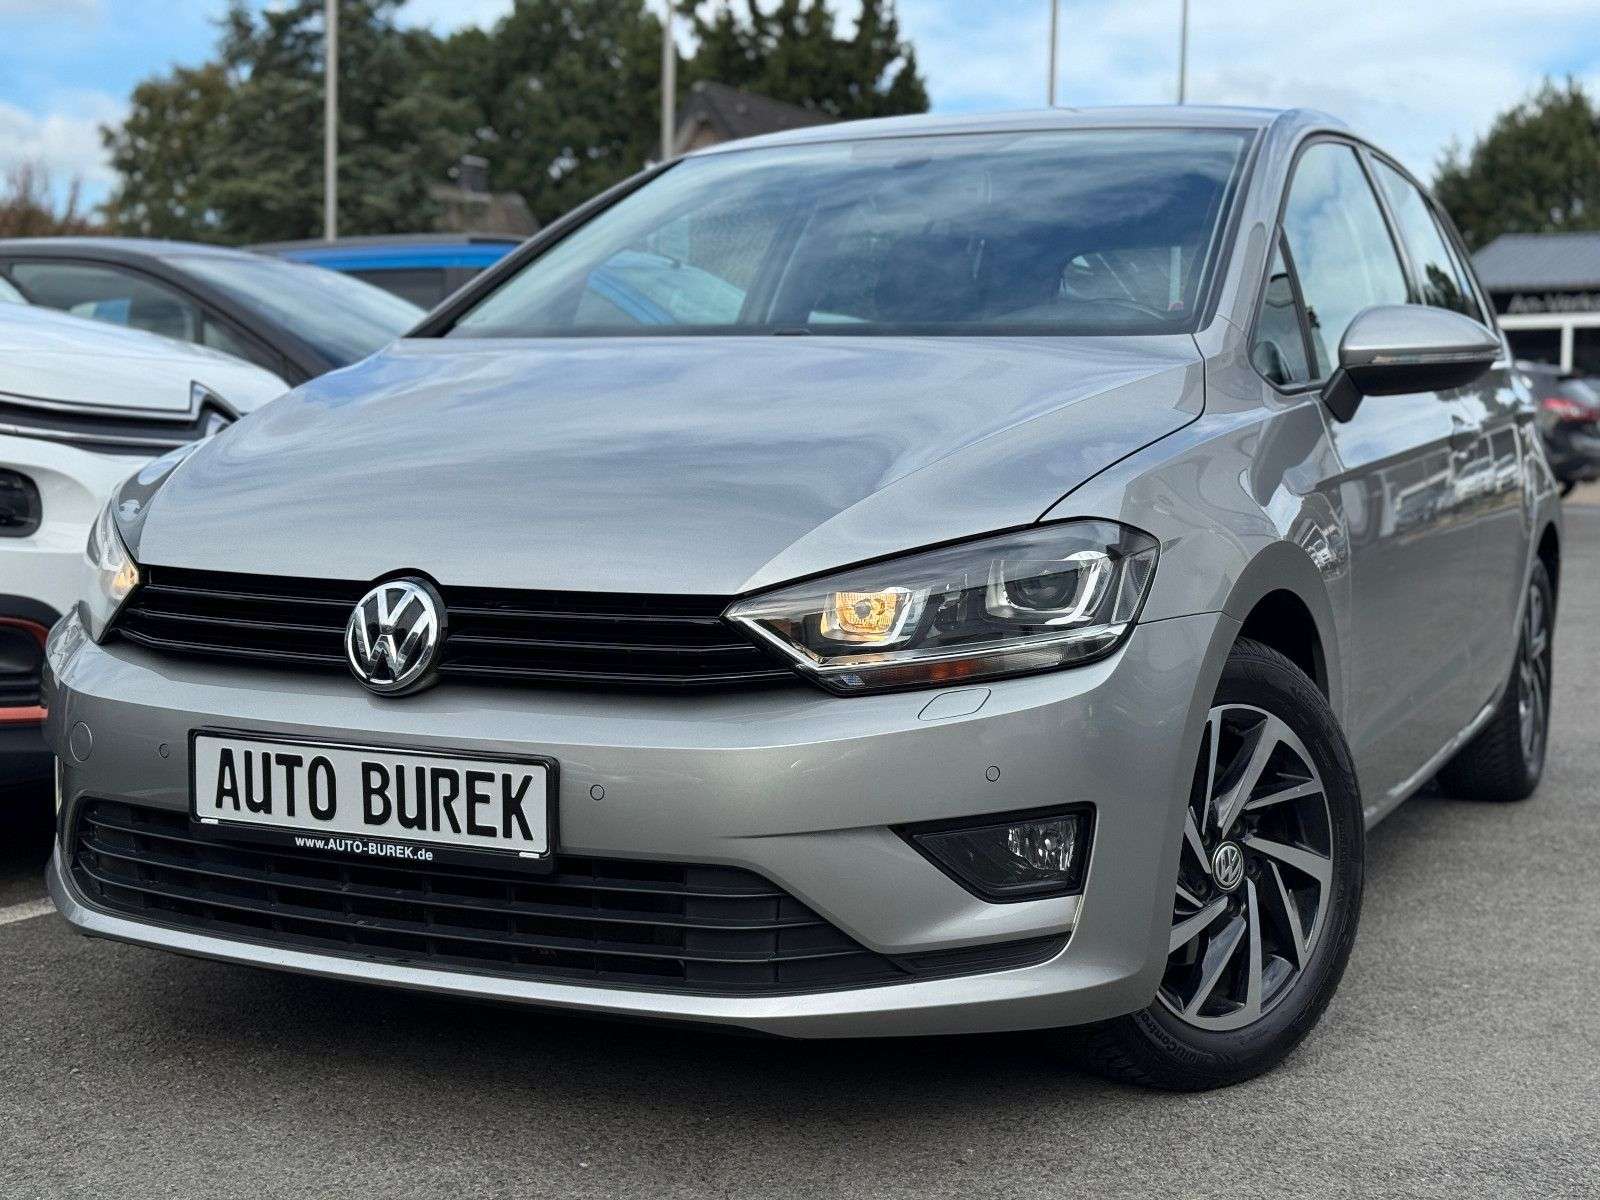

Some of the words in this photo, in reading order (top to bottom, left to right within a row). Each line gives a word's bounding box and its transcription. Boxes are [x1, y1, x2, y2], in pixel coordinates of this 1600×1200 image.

[215, 747, 337, 821] AUTO
[361, 761, 534, 841] BUREK
[295, 837, 433, 861] www.AUTO-BUREK.de
